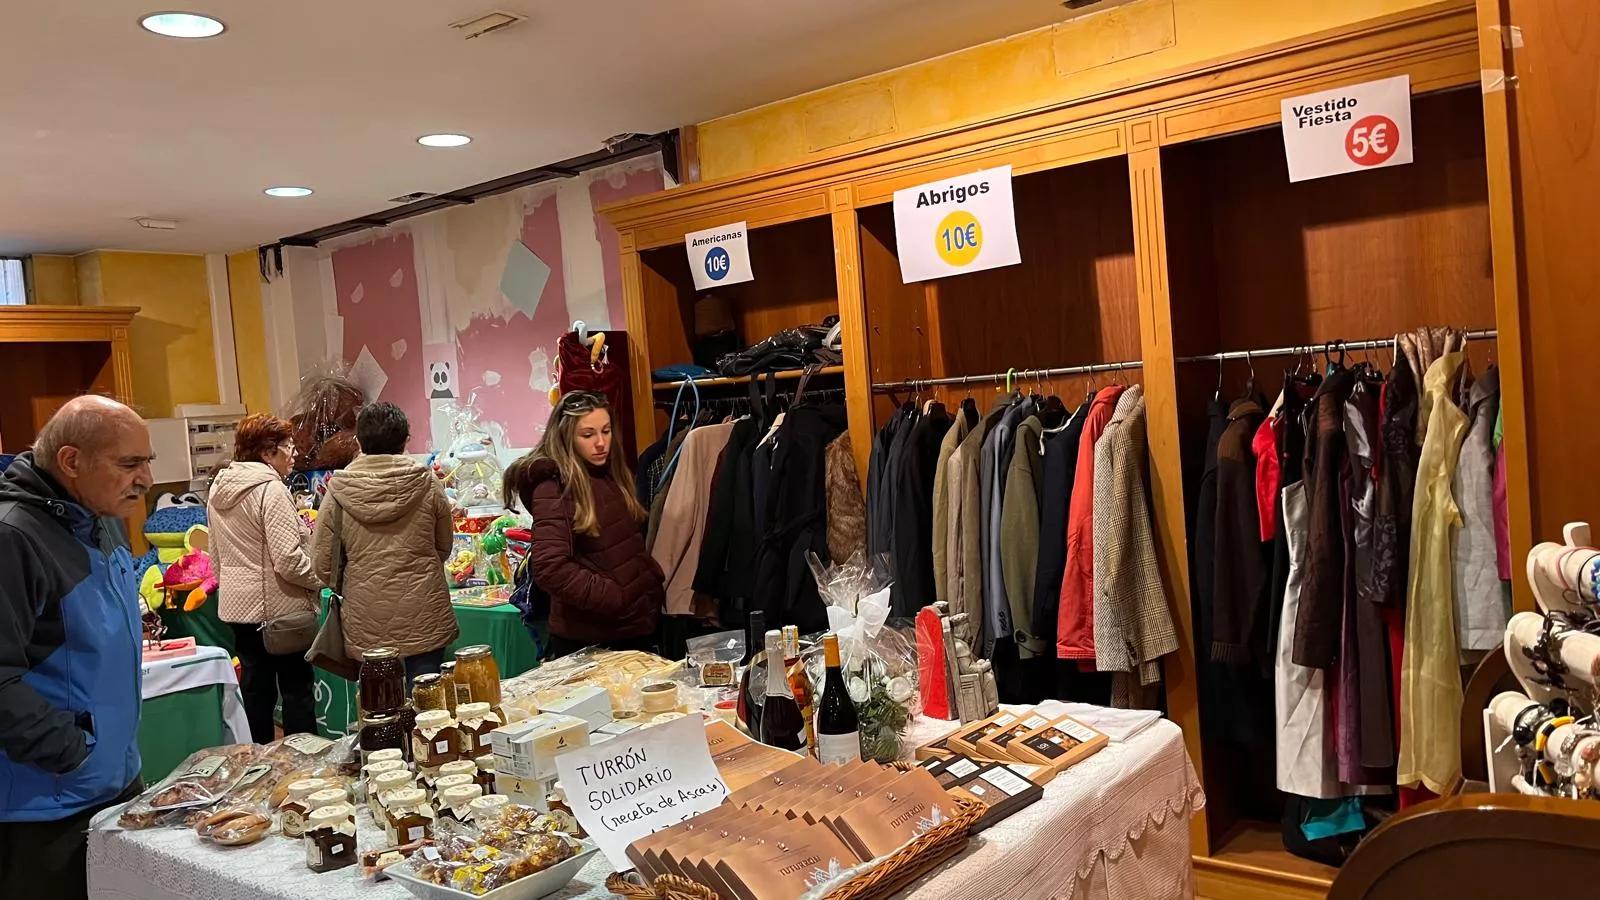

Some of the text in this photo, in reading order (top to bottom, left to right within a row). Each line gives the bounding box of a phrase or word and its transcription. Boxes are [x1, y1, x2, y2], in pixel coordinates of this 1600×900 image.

[1292, 97, 1357, 117] Vestido
[1298, 111, 1352, 128] Fiesta
[1351, 122, 1388, 158] 5€
[916, 181, 990, 208] Abrigos
[691, 231, 742, 247] Americanas
[942, 222, 978, 251] 10€
[706, 254, 727, 273] 10€
[575, 746, 647, 786] TURRÓN
[600, 802, 658, 832] (receta
[658, 796, 677, 808] de
[678, 777, 726, 804] Ascaso)
